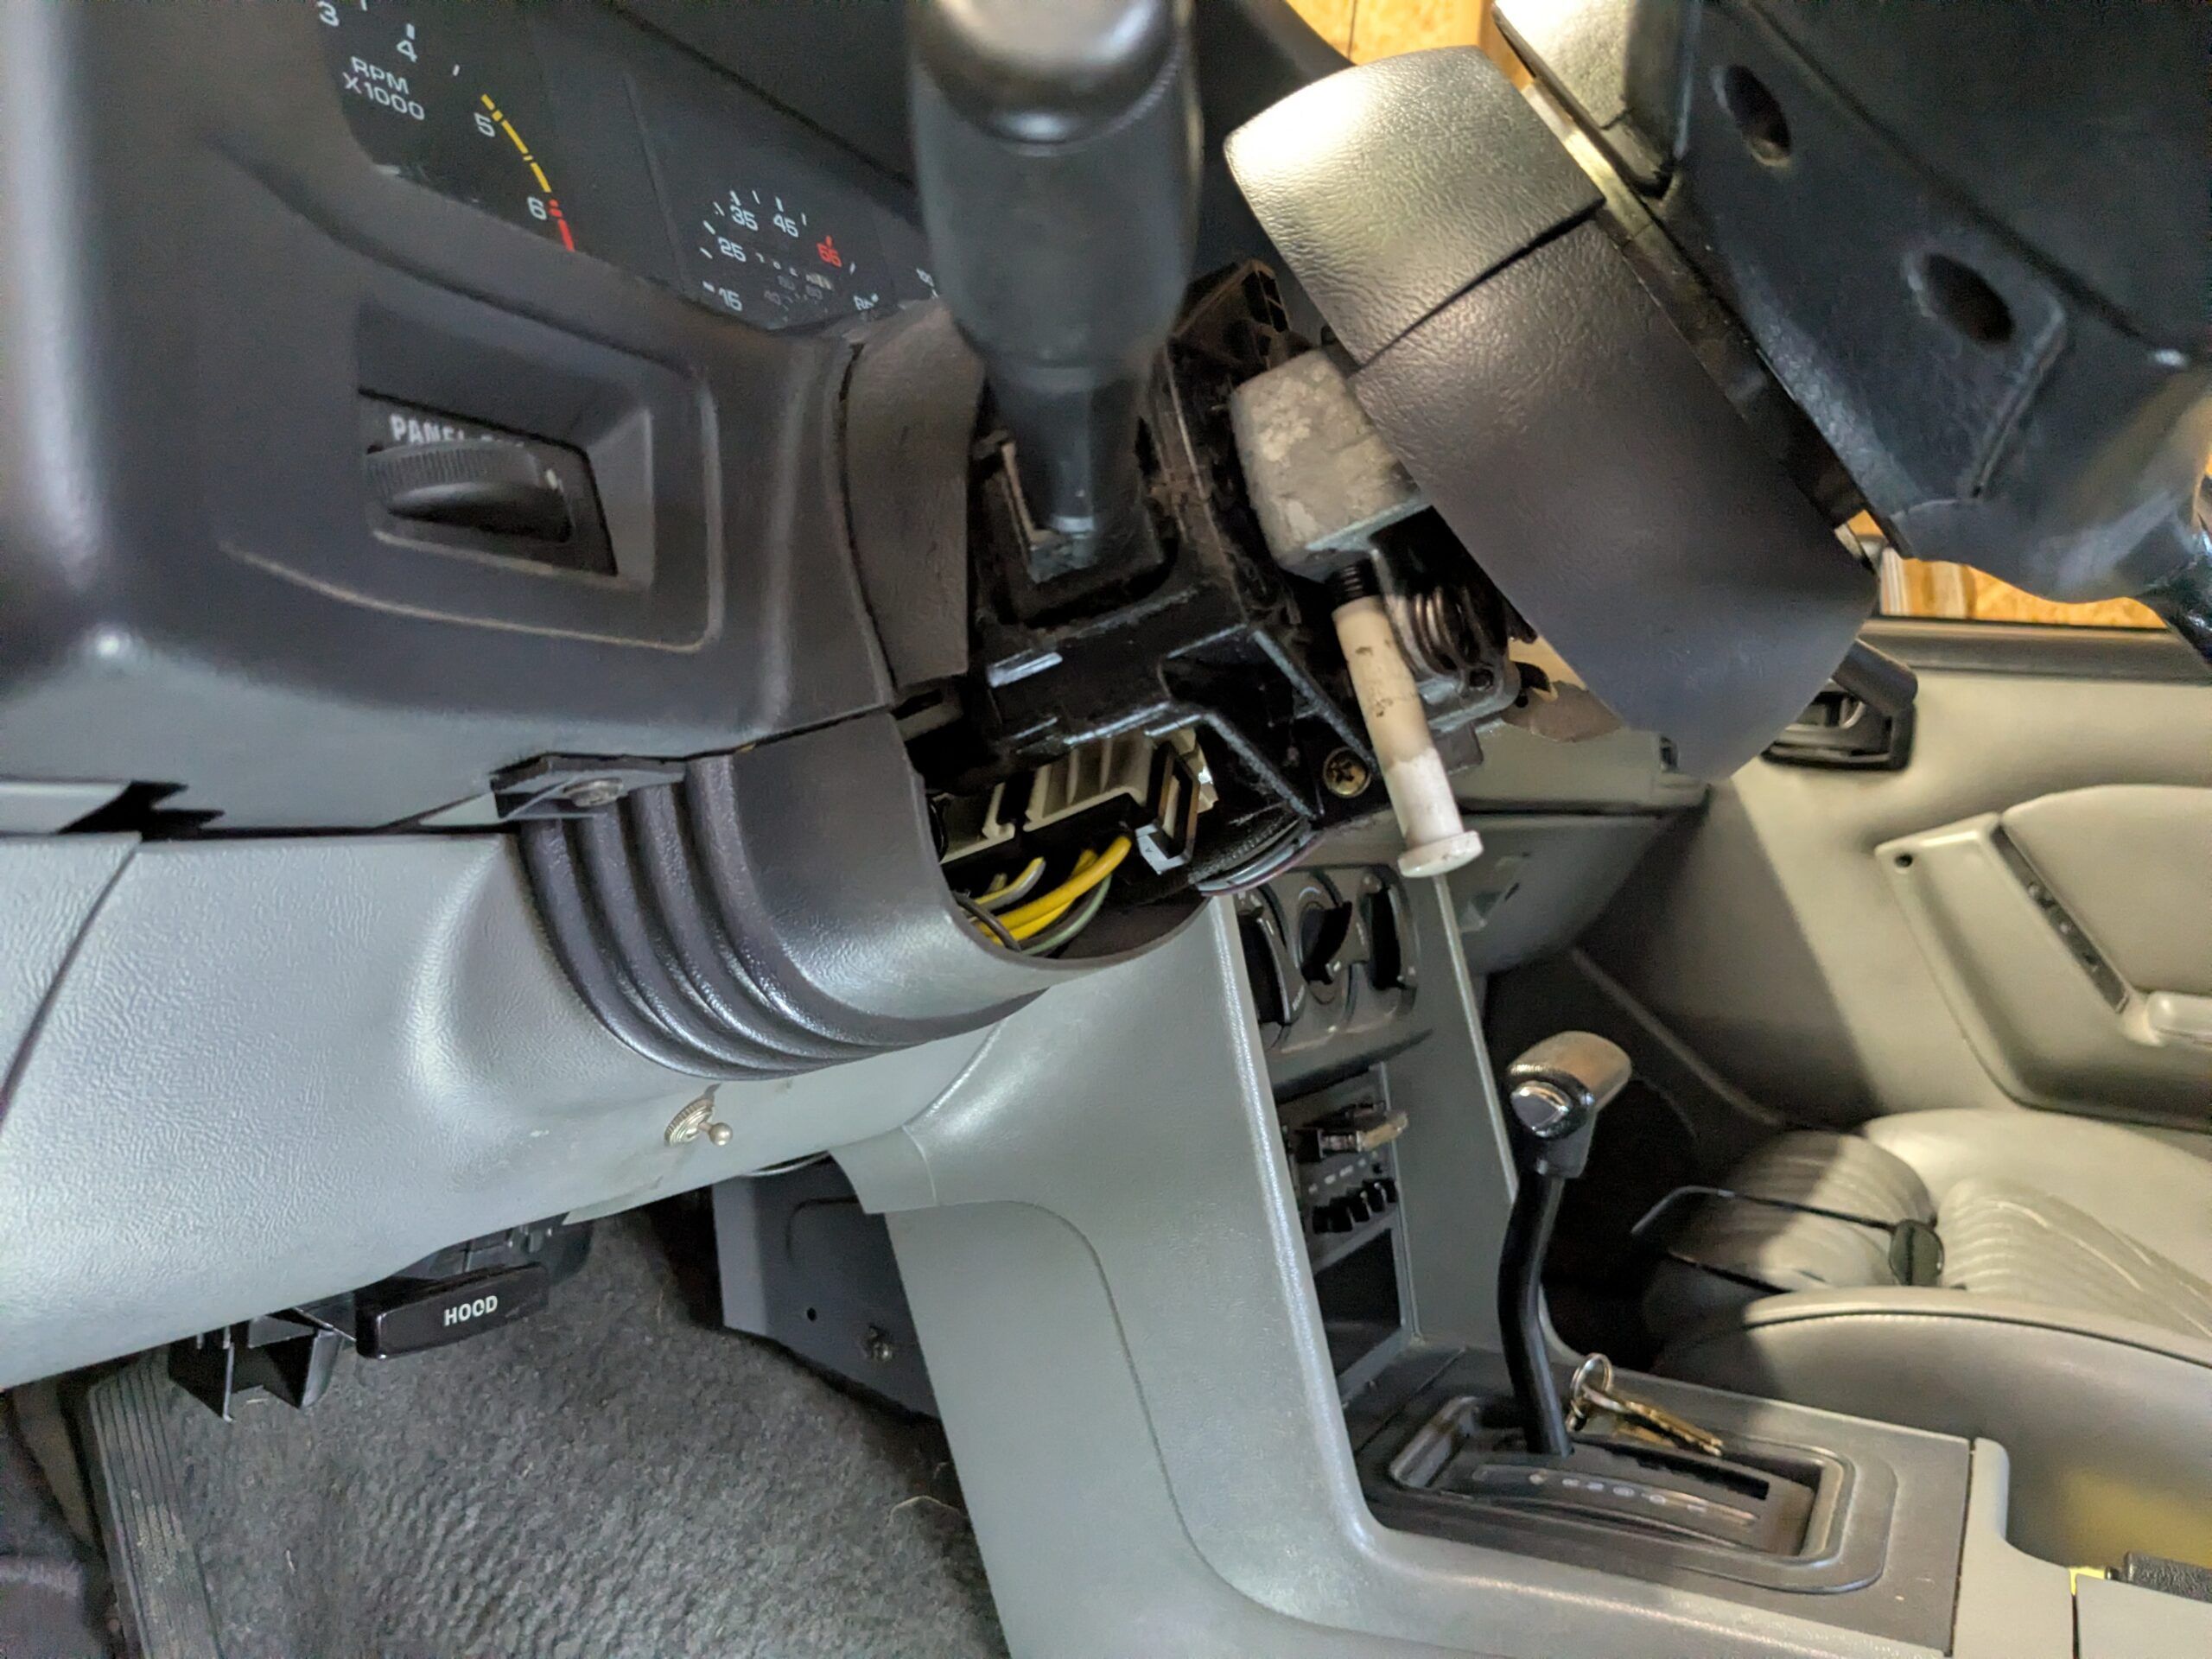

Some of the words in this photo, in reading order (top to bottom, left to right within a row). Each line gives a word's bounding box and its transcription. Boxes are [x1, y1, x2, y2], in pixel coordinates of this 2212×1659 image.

[317, 1, 339, 26] 3
[397, 40, 417, 62] 4
[351, 56, 409, 94] RPM
[342, 72, 424, 119] X1000
[474, 112, 495, 137] 5
[527, 196, 547, 219] 6
[730, 205, 759, 231] 35
[773, 213, 798, 238] 45
[718, 237, 747, 262] 25
[719, 287, 742, 311] 15
[443, 1295, 498, 1326] HOOD
